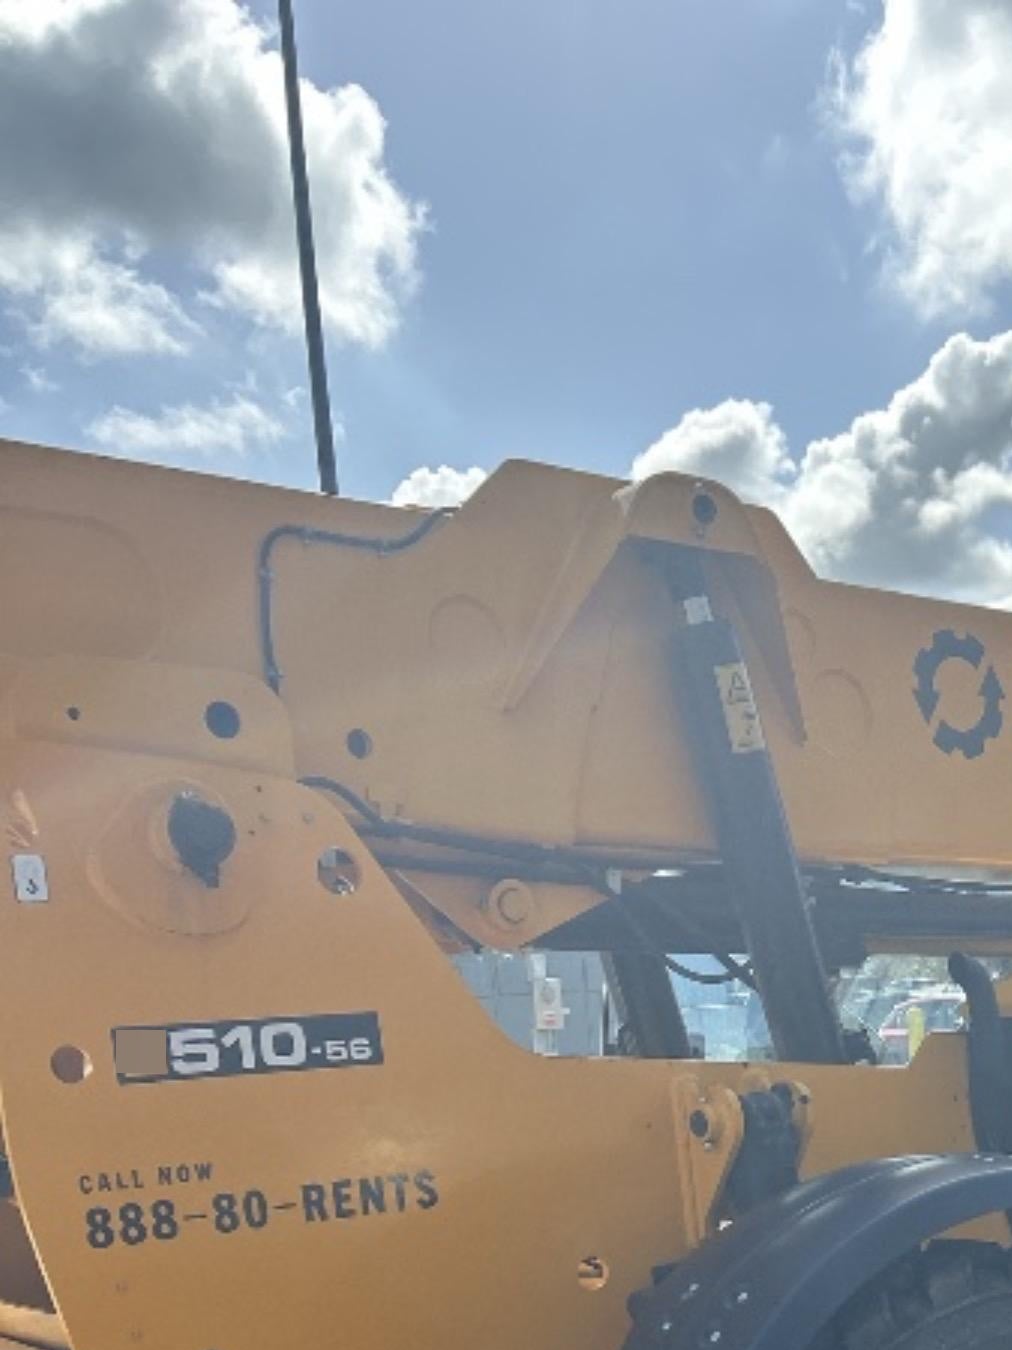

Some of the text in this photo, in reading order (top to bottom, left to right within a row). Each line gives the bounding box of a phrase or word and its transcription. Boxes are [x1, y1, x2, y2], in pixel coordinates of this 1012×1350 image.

[79, 1162, 214, 1195] CALL NOW
[86, 1169, 440, 1249] 888-80-RENTS
